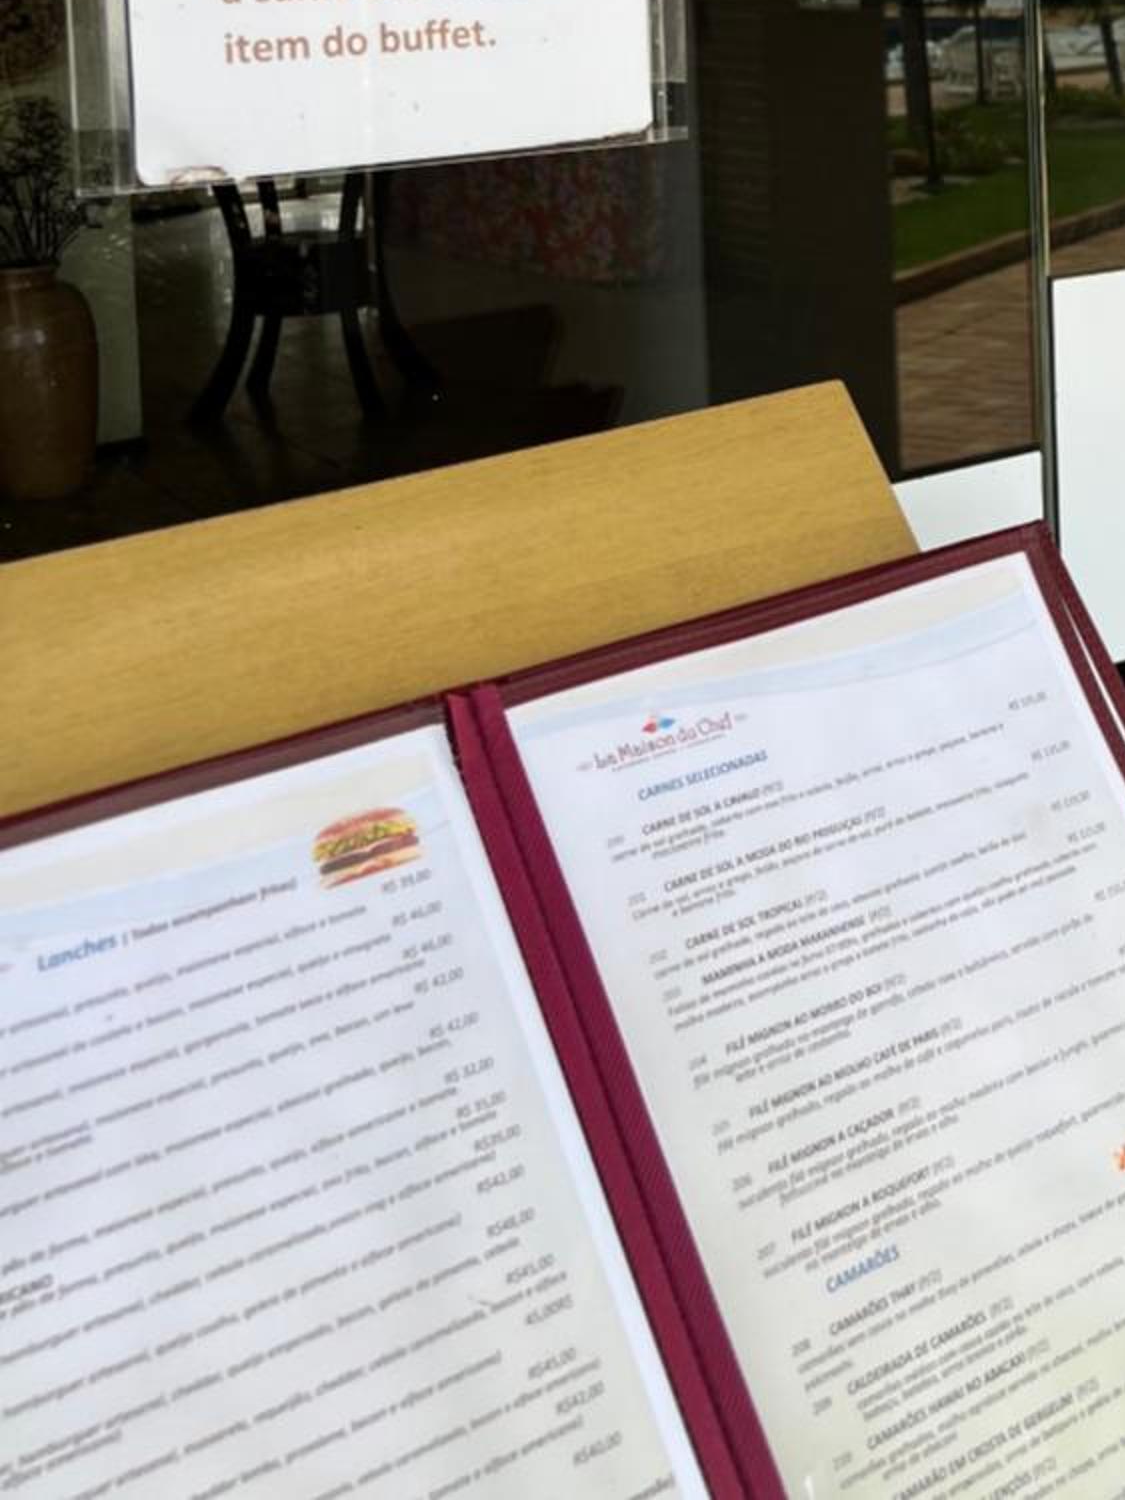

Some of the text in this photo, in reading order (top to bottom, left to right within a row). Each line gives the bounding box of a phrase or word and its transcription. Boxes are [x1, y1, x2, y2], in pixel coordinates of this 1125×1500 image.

[223, 19, 497, 64] item do buffet.
[36, 934, 118, 972] Lanches
[825, 1244, 901, 1294] CAMARÕES
